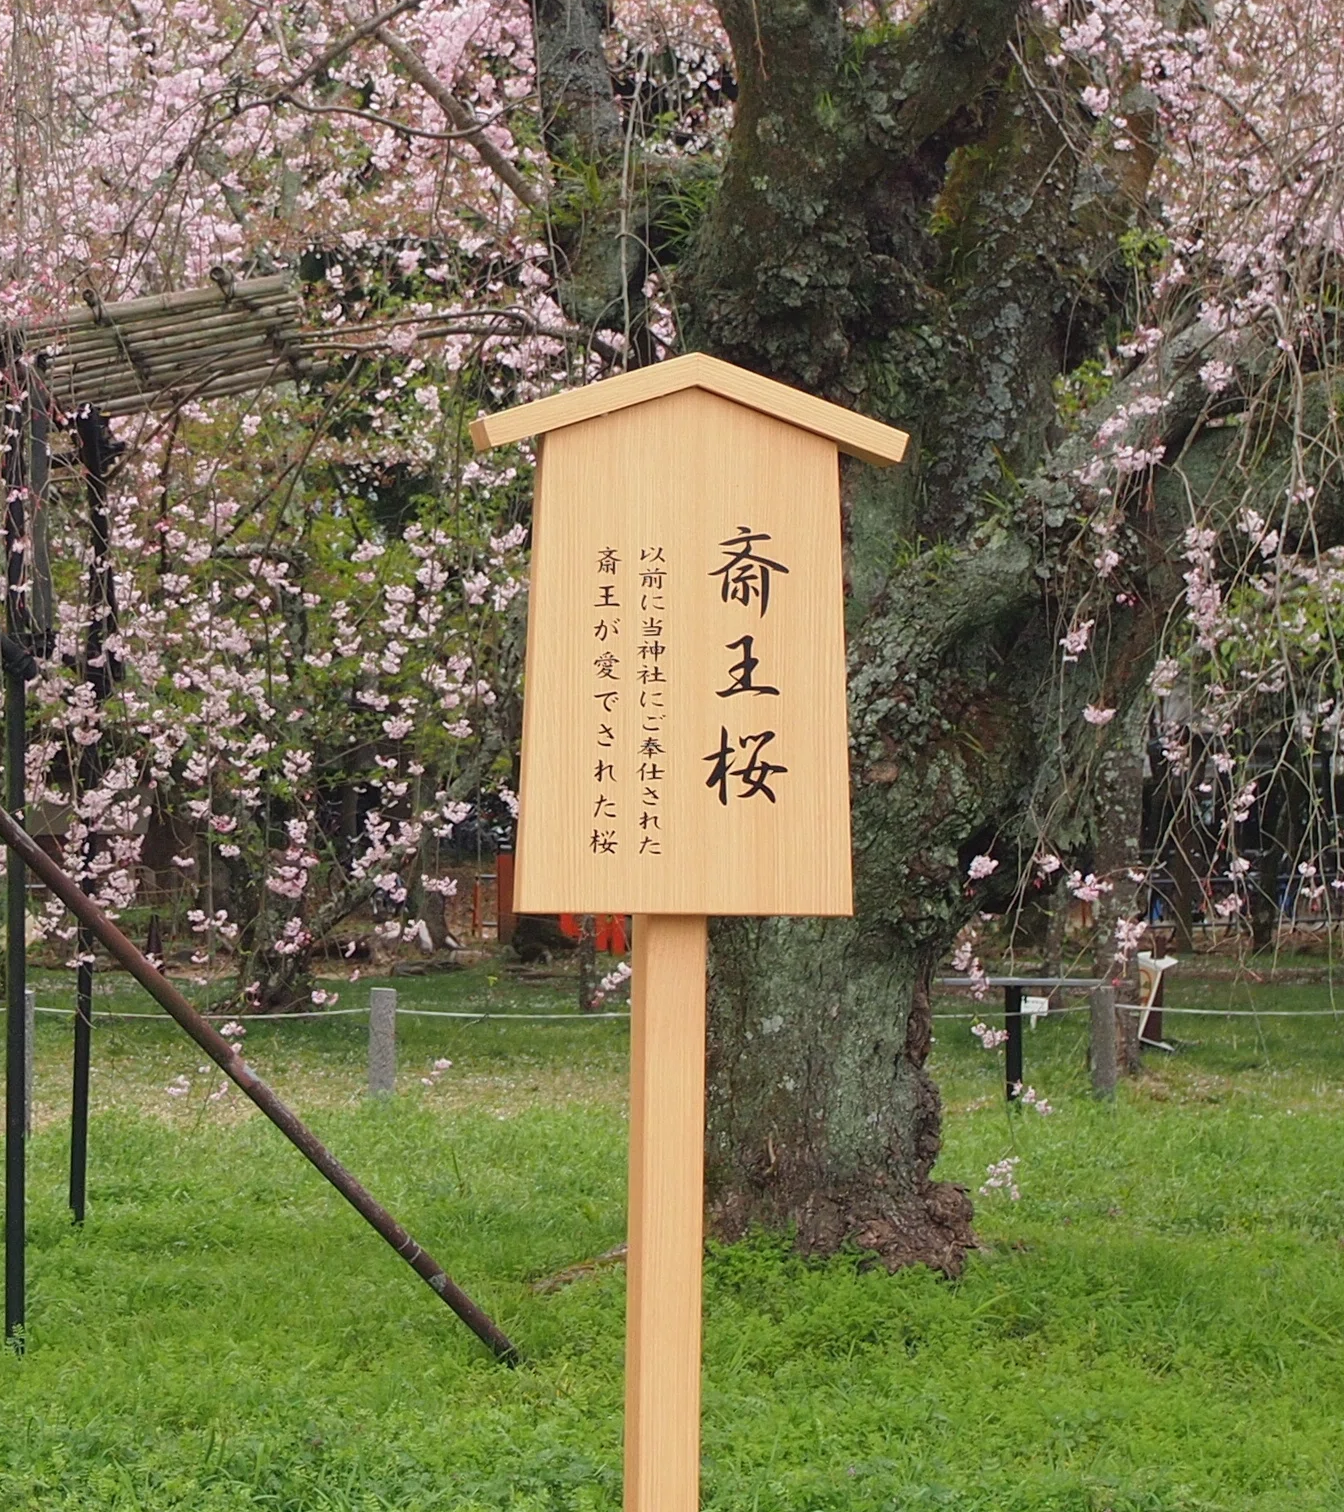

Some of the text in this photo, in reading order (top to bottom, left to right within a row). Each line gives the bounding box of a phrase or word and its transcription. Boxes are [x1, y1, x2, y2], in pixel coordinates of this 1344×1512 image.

[589, 546, 622, 855] 斎王が愛でされた桜
[636, 546, 668, 855] 以前に当神社にご奉仕された
[702, 526, 790, 806] 斎王桜
